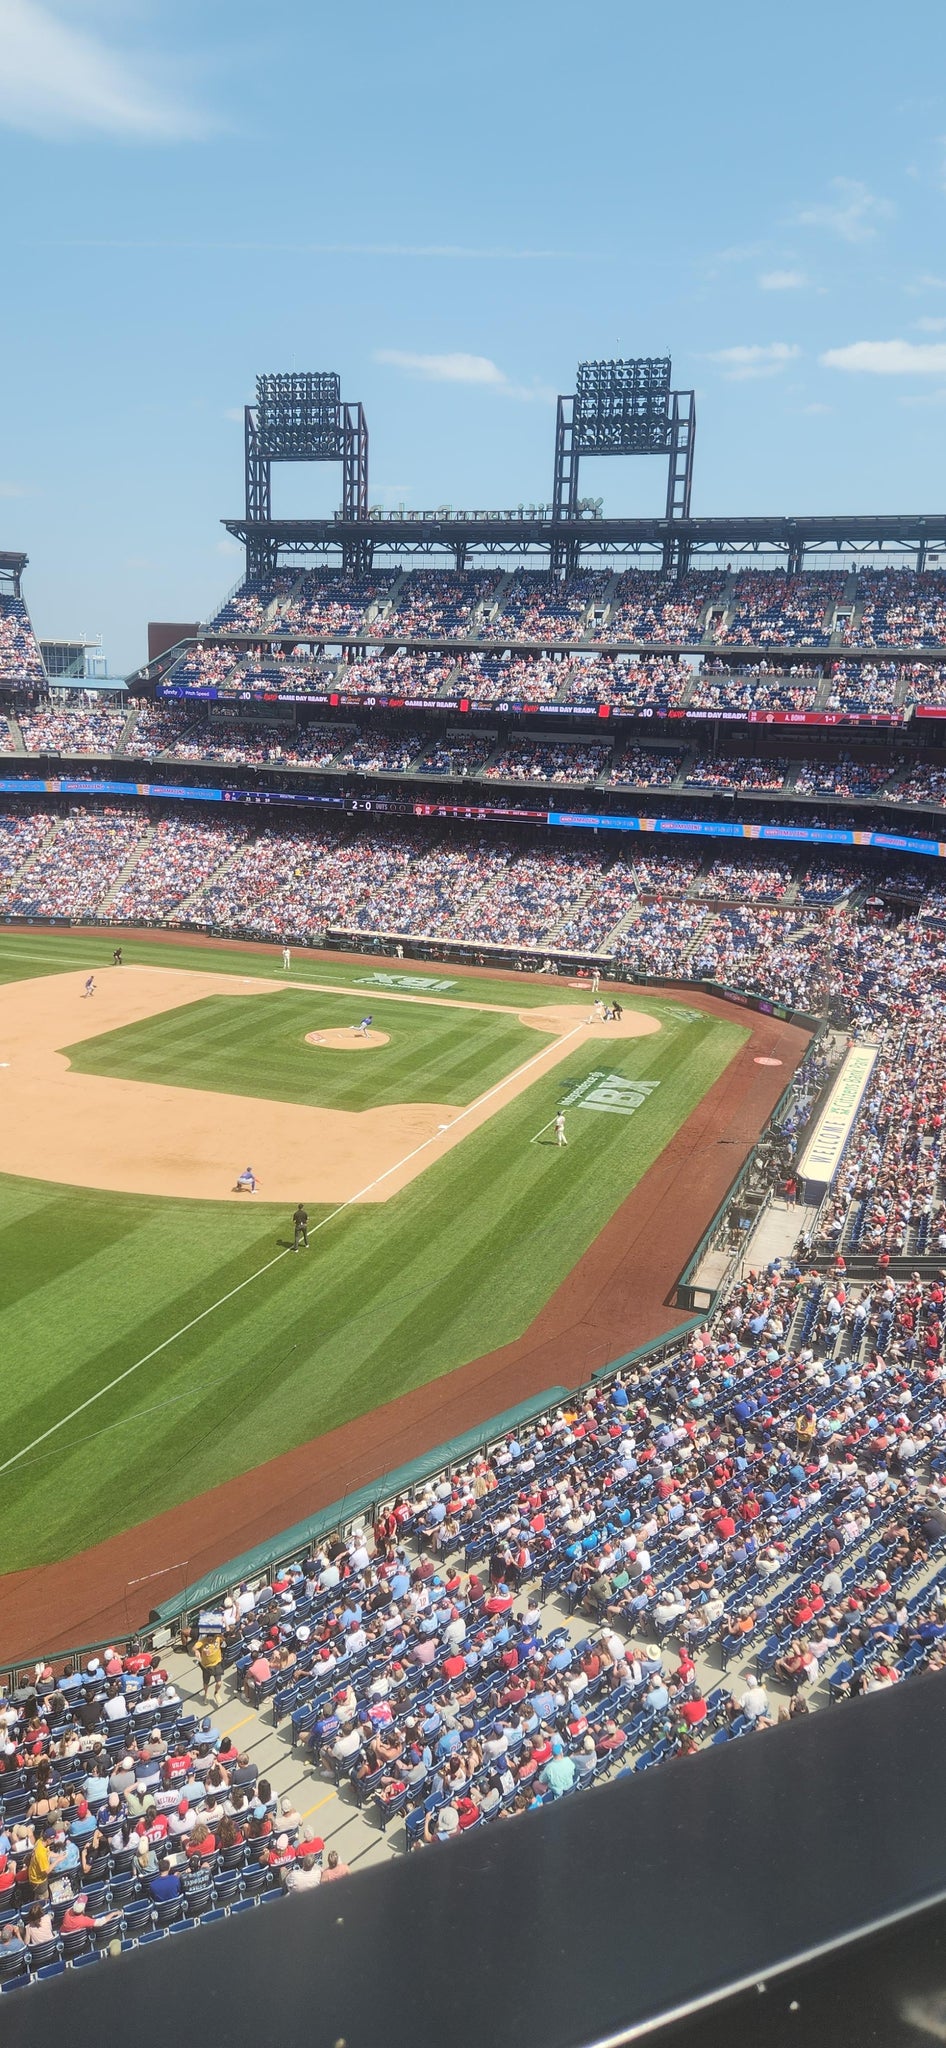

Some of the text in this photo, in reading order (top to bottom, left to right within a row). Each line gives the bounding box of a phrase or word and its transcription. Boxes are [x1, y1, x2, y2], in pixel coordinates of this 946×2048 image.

[242, 691, 251, 700] 10
[366, 697, 376, 706] 10
[499, 703, 509, 712] 10
[642, 708, 653, 717] 10
[577, 1074, 661, 1115] IBX
[809, 1056, 870, 1164] WELCOME Citizens Bank Park
